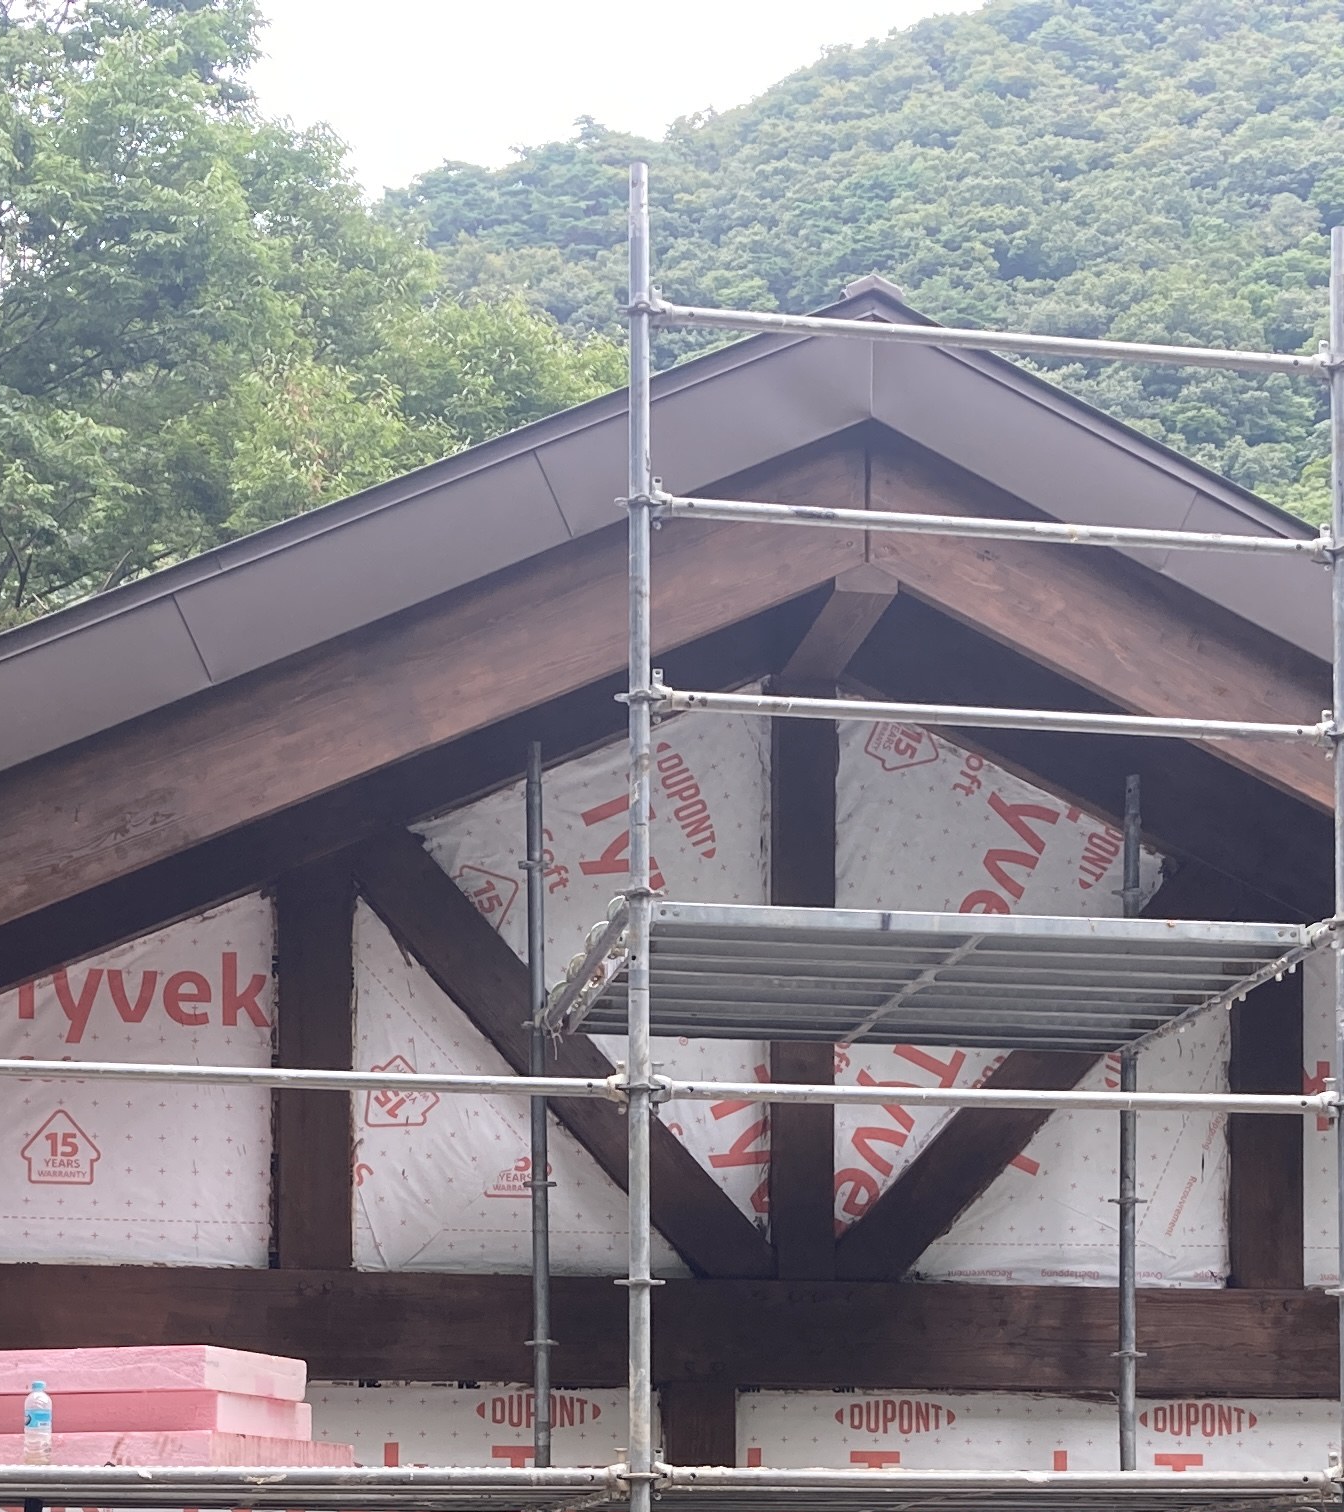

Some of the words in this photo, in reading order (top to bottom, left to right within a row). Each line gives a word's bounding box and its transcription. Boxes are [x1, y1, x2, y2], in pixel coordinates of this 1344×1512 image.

[883, 723, 900, 752] EARS
[894, 728, 923, 760] 15
[952, 753, 984, 796] oft
[657, 753, 714, 847] DUPONT
[472, 881, 502, 915] 15
[45, 1133, 79, 1157] 15
[37, 1169, 88, 1179] WARRANTY
[43, 1158, 80, 1169] YEARS
[849, 1399, 942, 1434] DUPONT
[1154, 1403, 1244, 1437] DUPONT
